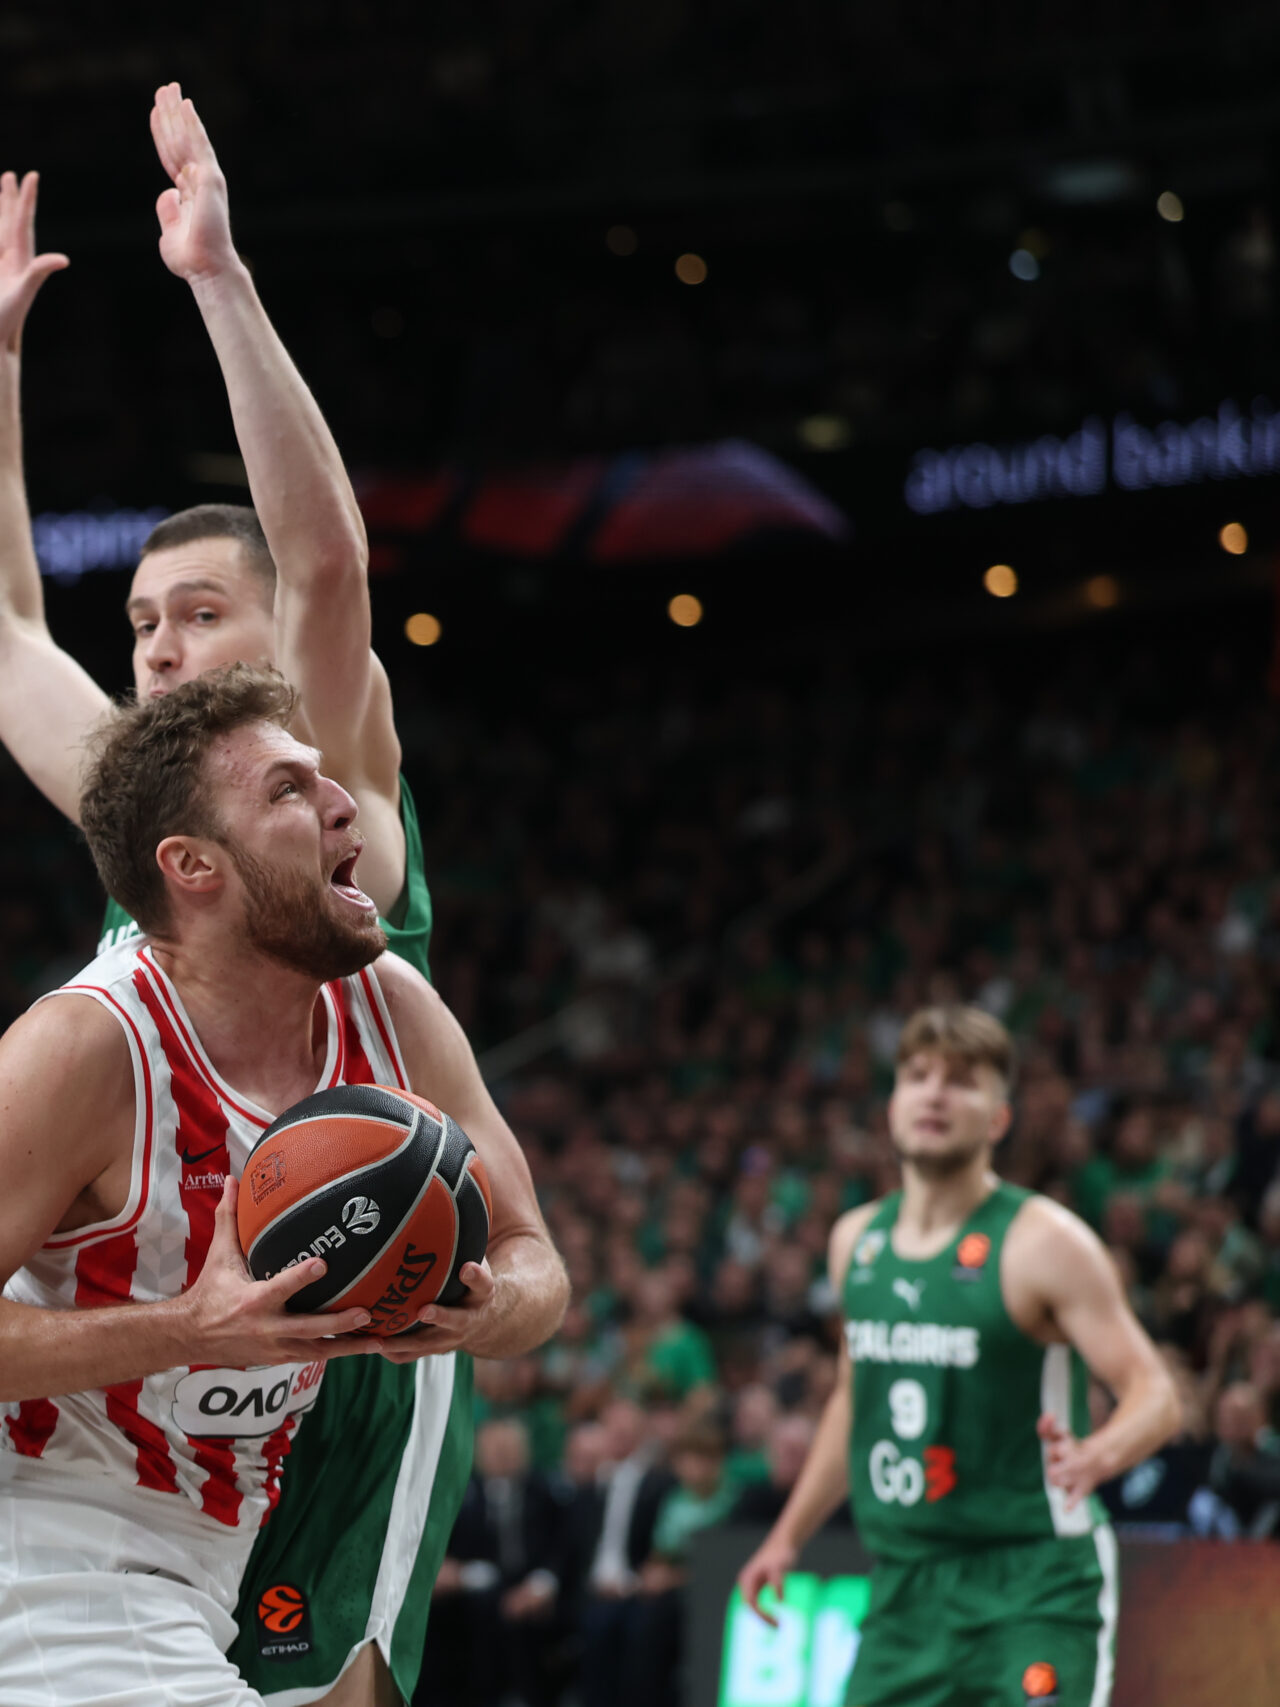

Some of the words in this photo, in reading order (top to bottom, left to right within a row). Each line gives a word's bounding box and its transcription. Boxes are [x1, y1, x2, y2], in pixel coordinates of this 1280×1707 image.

[888, 1379, 927, 1439] 9
[869, 1440, 957, 1506] Go3
[261, 1641, 309, 1656] ETIHAD
